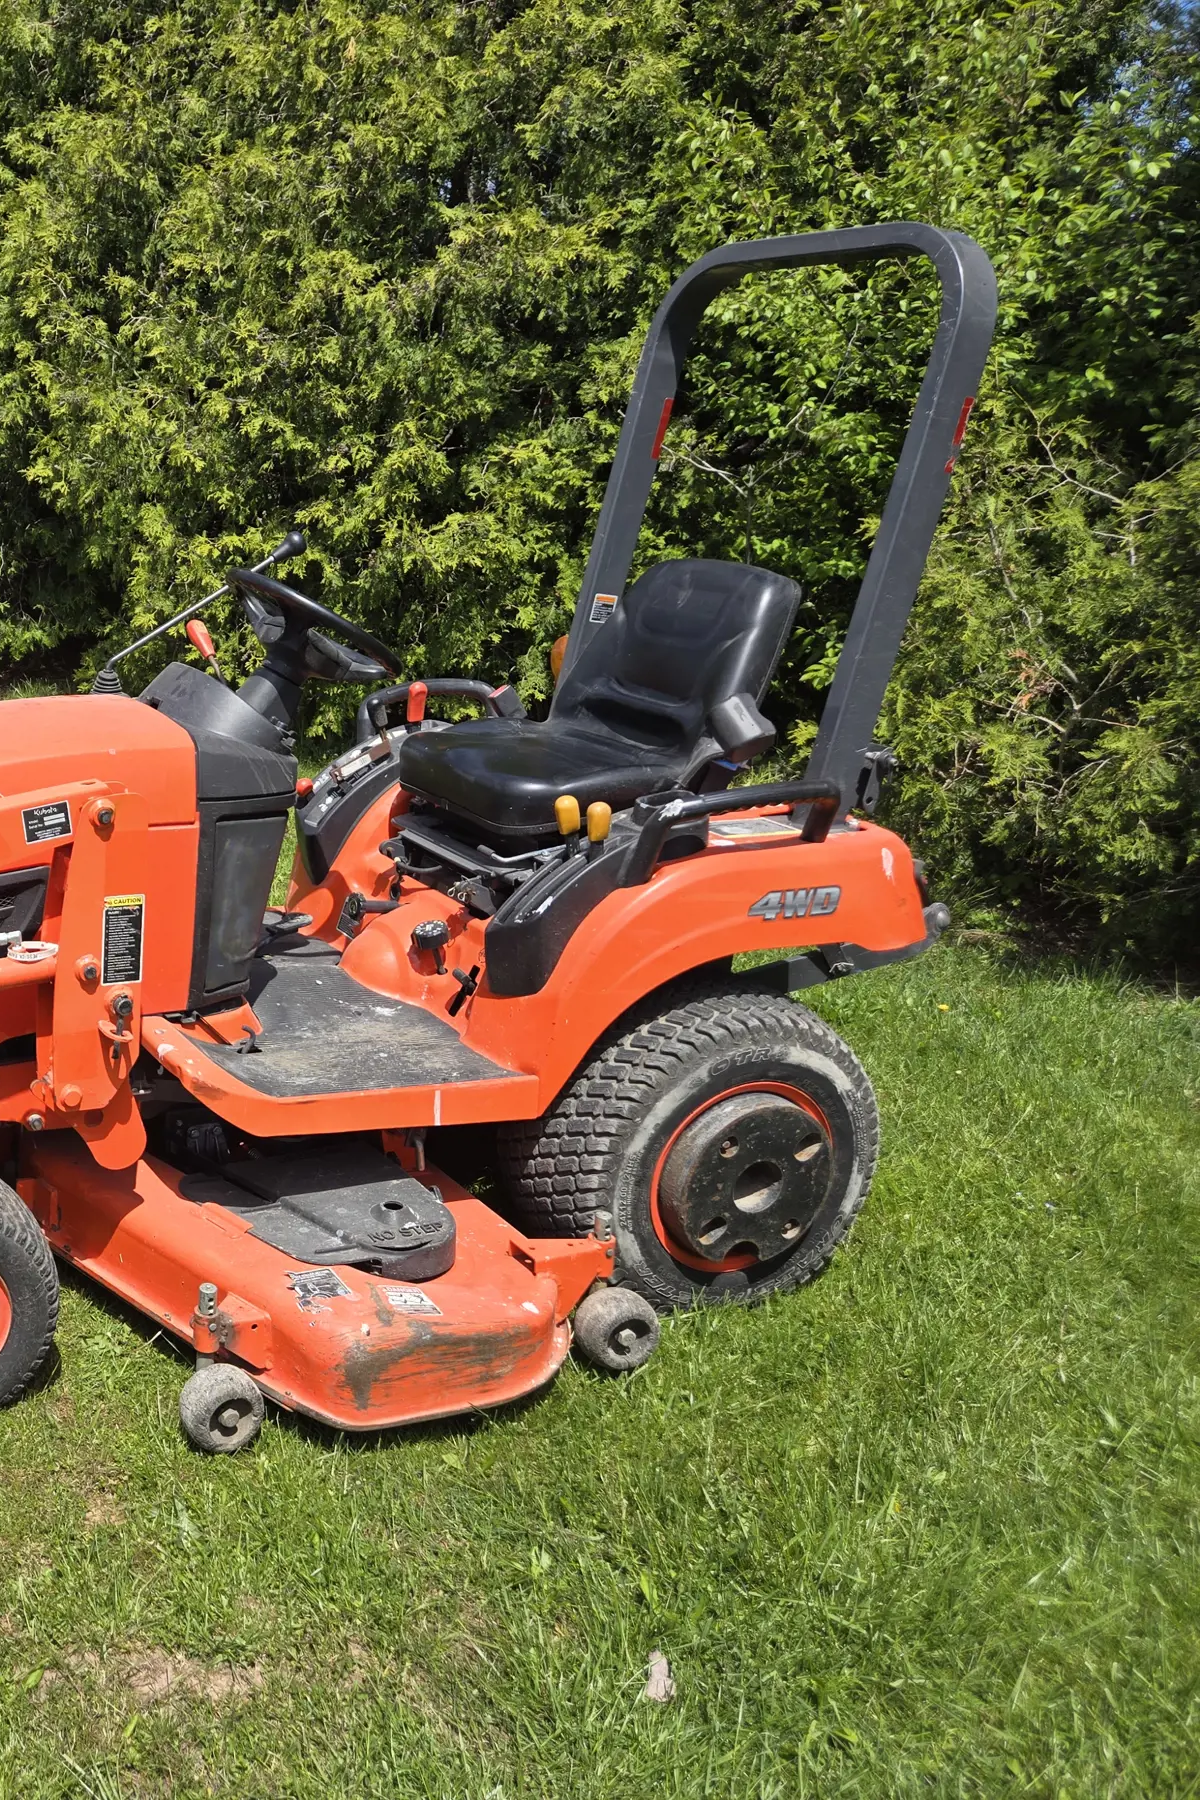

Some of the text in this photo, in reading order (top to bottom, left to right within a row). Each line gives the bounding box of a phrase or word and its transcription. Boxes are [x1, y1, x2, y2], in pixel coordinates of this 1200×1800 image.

[113, 897, 142, 905] CAUTION
[747, 885, 841, 921] 4WD
[711, 1047, 772, 1076] OTR
[367, 1222, 443, 1243] NO STEP
